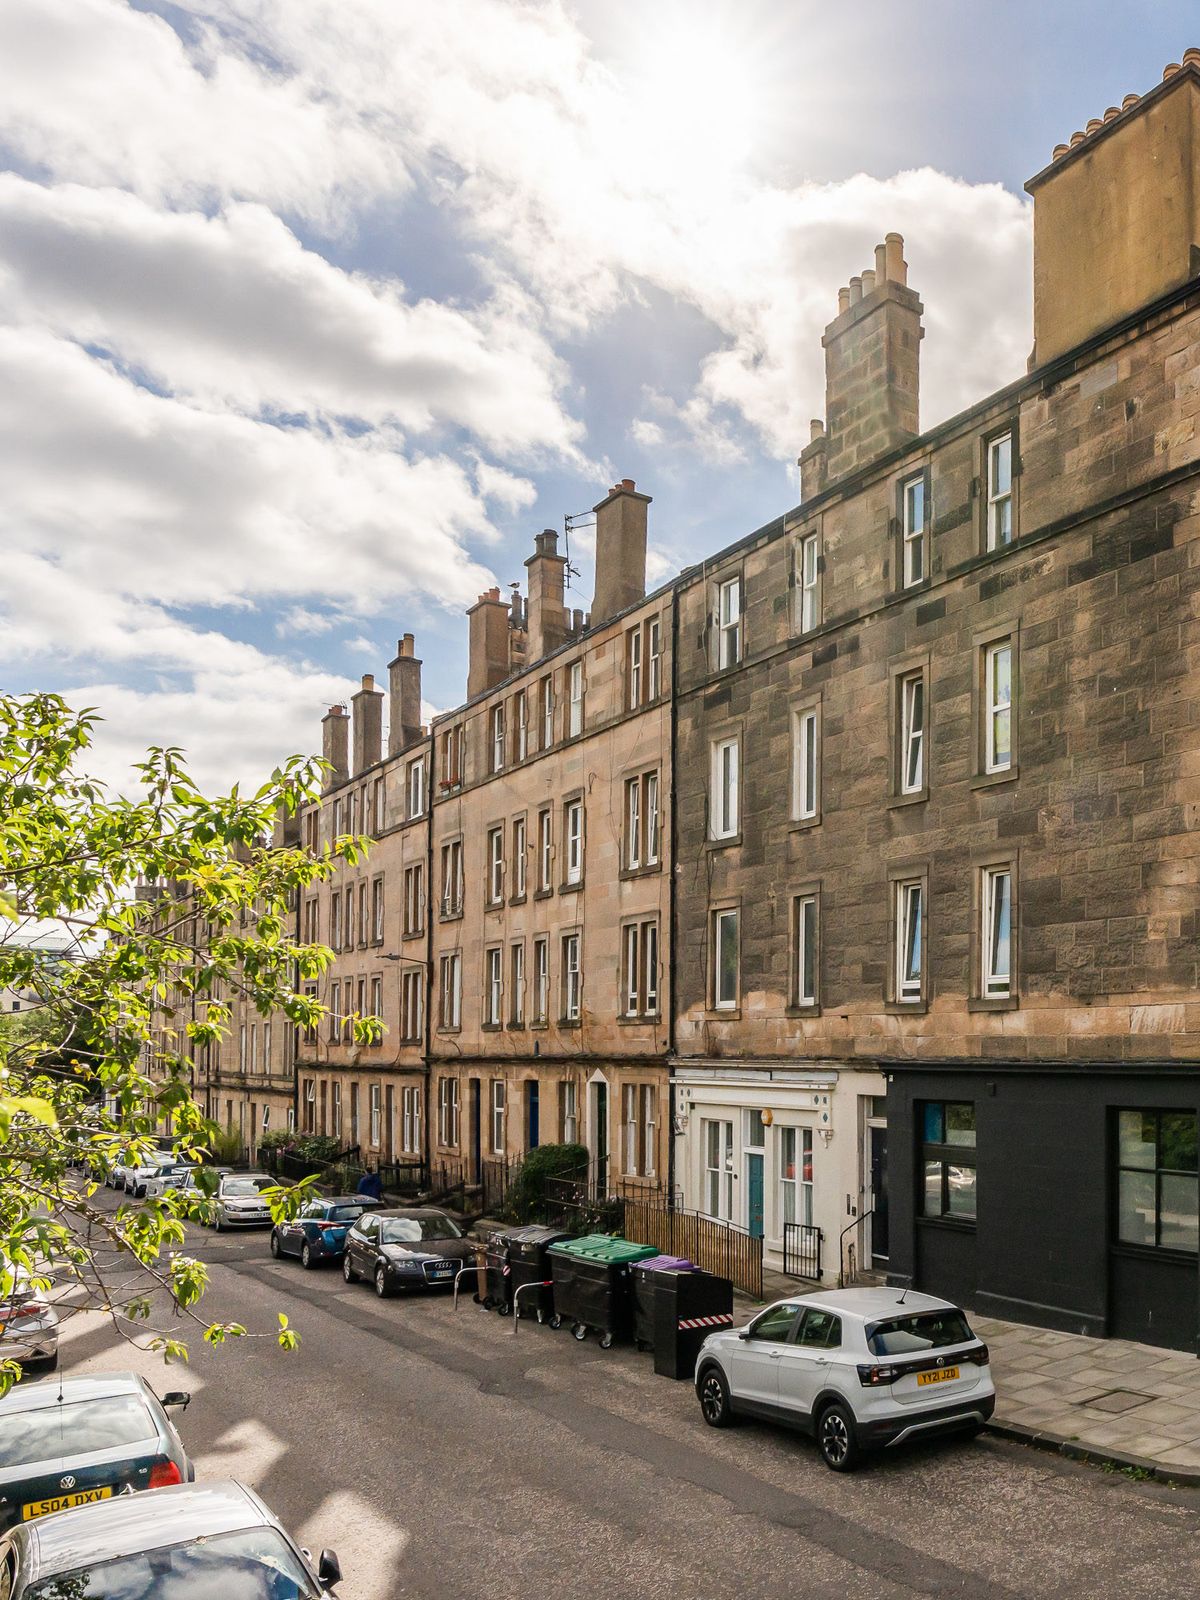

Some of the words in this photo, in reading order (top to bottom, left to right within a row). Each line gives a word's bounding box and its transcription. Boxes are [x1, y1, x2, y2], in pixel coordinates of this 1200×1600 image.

[922, 1371, 940, 1383] YY21
[30, 1498, 70, 1517] LS04
[75, 1490, 103, 1507] DXV
